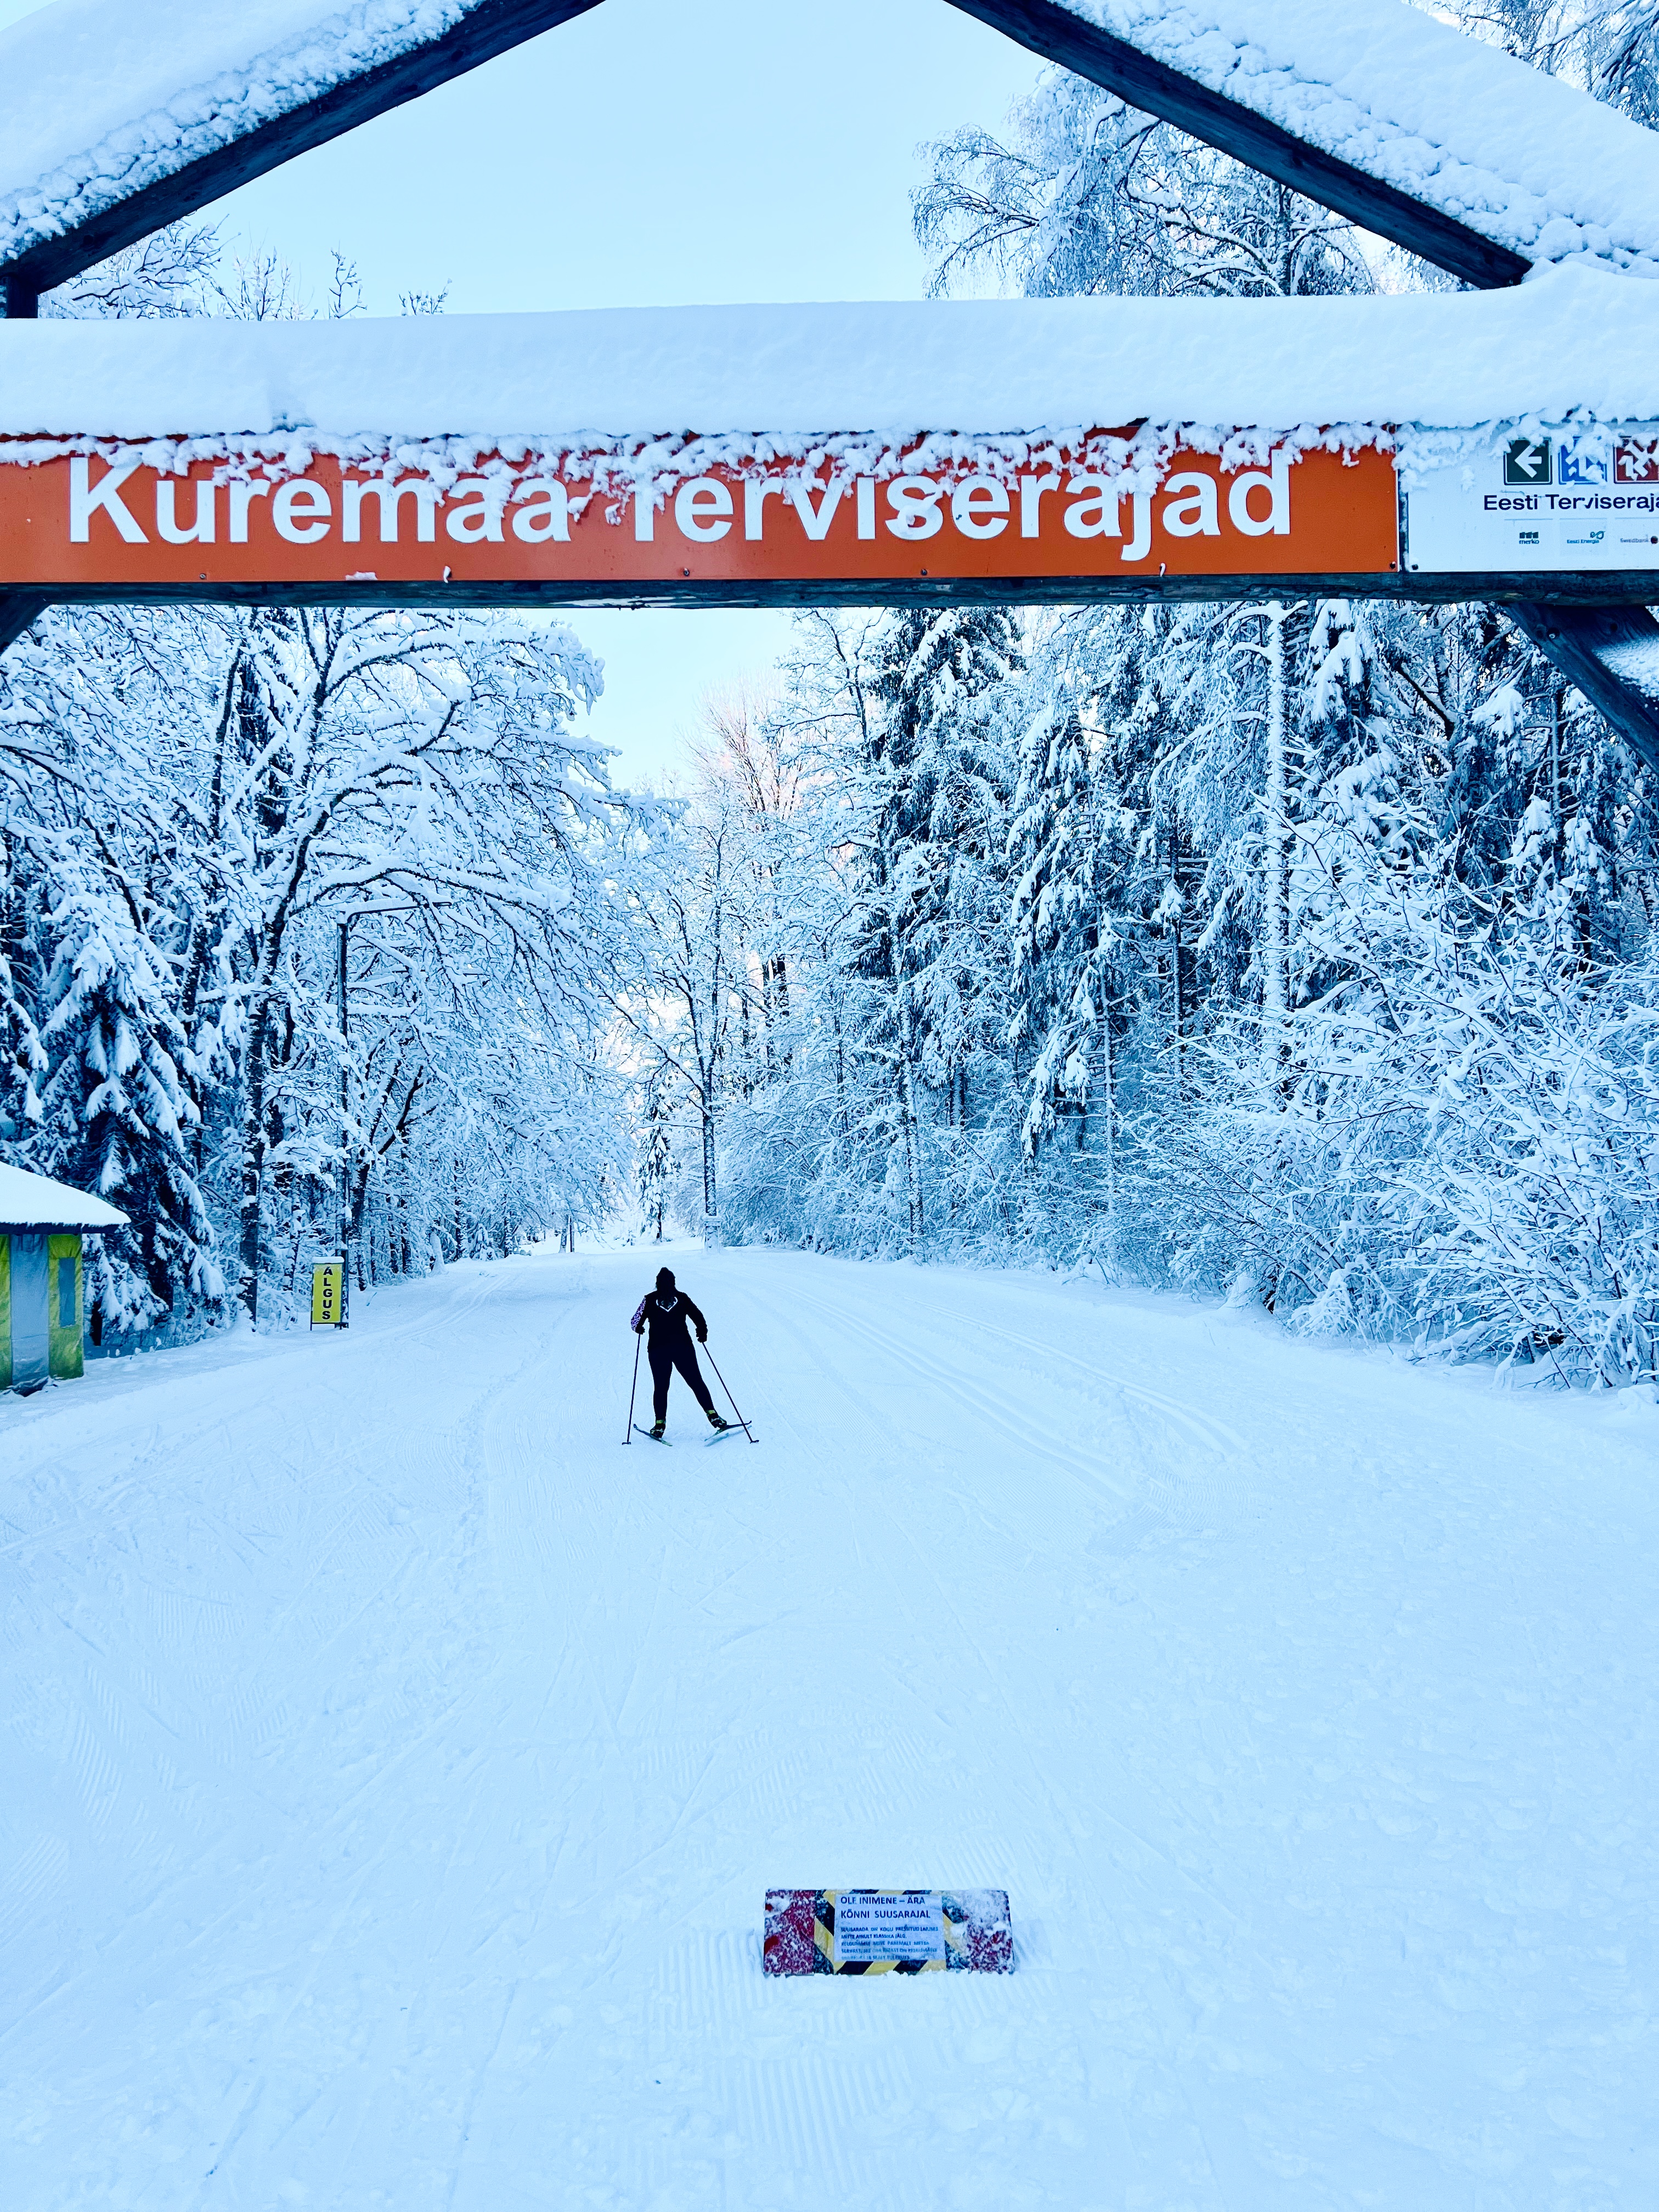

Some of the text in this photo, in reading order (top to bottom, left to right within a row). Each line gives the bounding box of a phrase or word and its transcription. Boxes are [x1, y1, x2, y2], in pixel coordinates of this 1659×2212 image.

[70, 456, 571, 544] Kuremaa
[1484, 493, 1659, 512] Eesti Terviseraj
[322, 1266, 333, 1320] ALGUS
[907, 1895, 925, 1904] ÄRA
[841, 1909, 930, 1918] KÕNNI SUUSARAJAL
